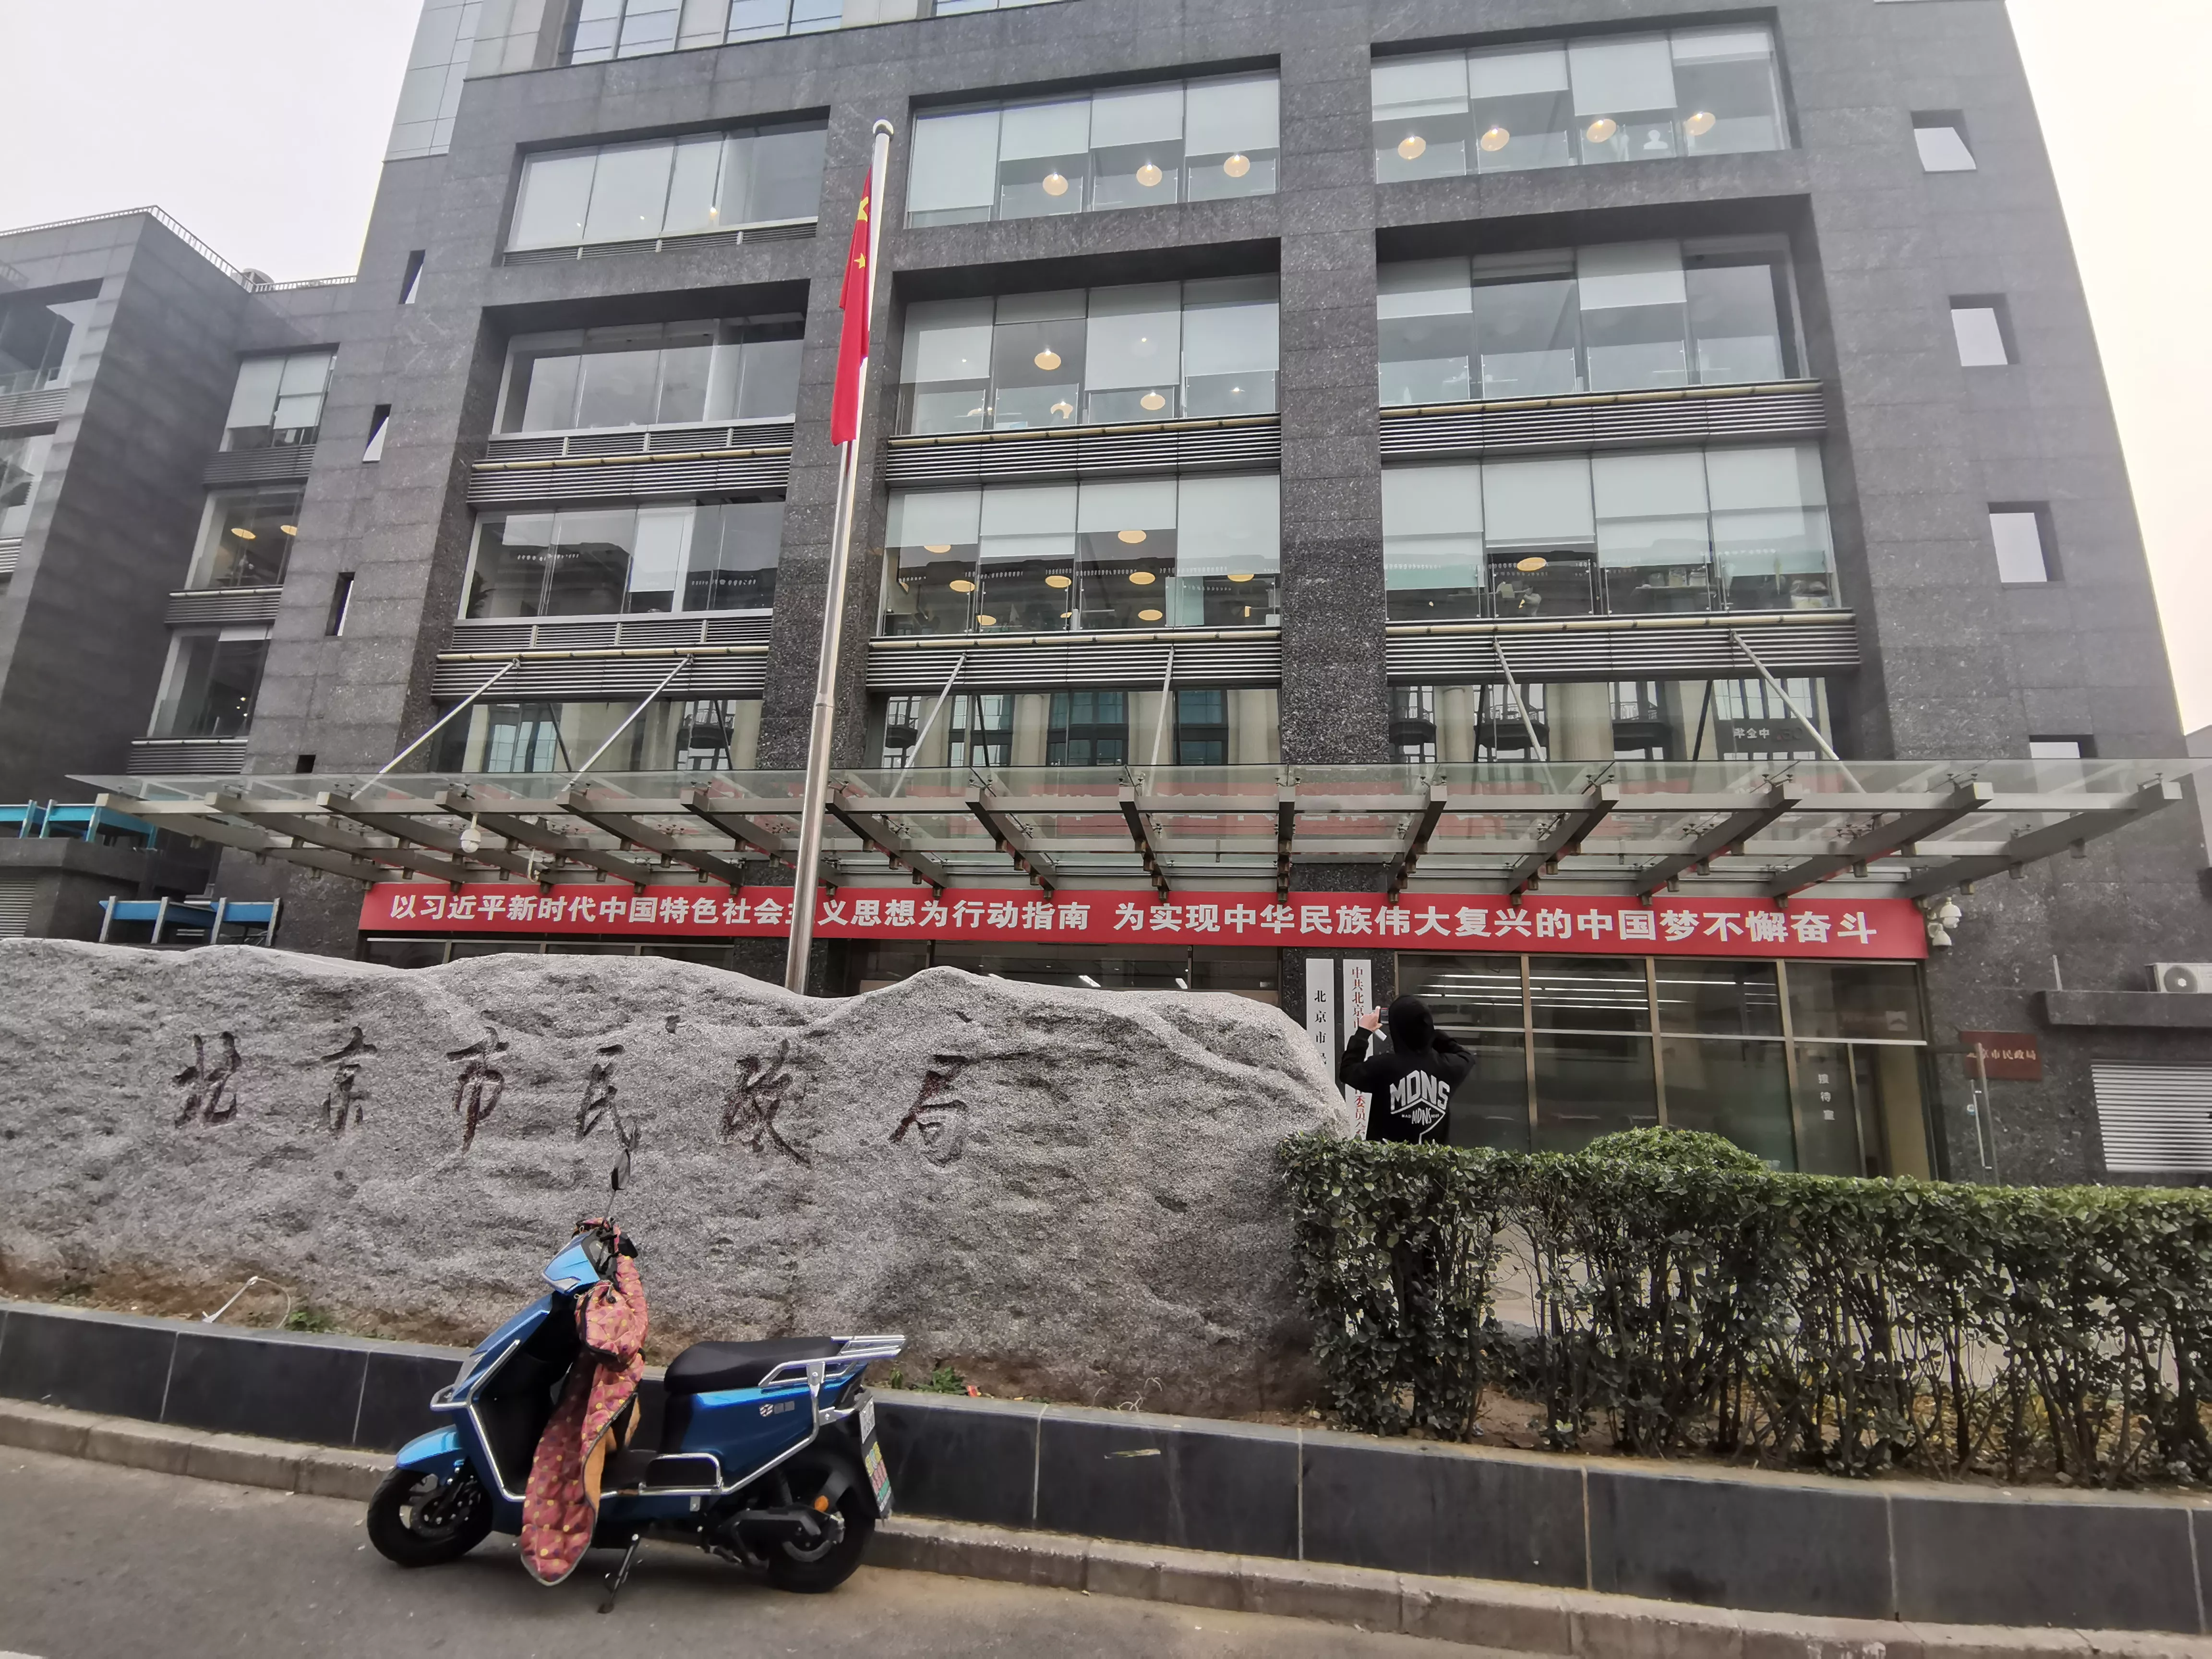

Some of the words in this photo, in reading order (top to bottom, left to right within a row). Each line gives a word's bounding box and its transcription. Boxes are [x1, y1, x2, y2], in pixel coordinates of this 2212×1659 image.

[390, 895, 1091, 930] 以习近平新时代中国特色社会义思想为行动指南
[1114, 902, 1876, 944] 为实现中华民族伟大复兴的中国梦不懈奋斗
[1390, 1070, 1450, 1111] MDNS
[1412, 1107, 1431, 1126] MDNS
